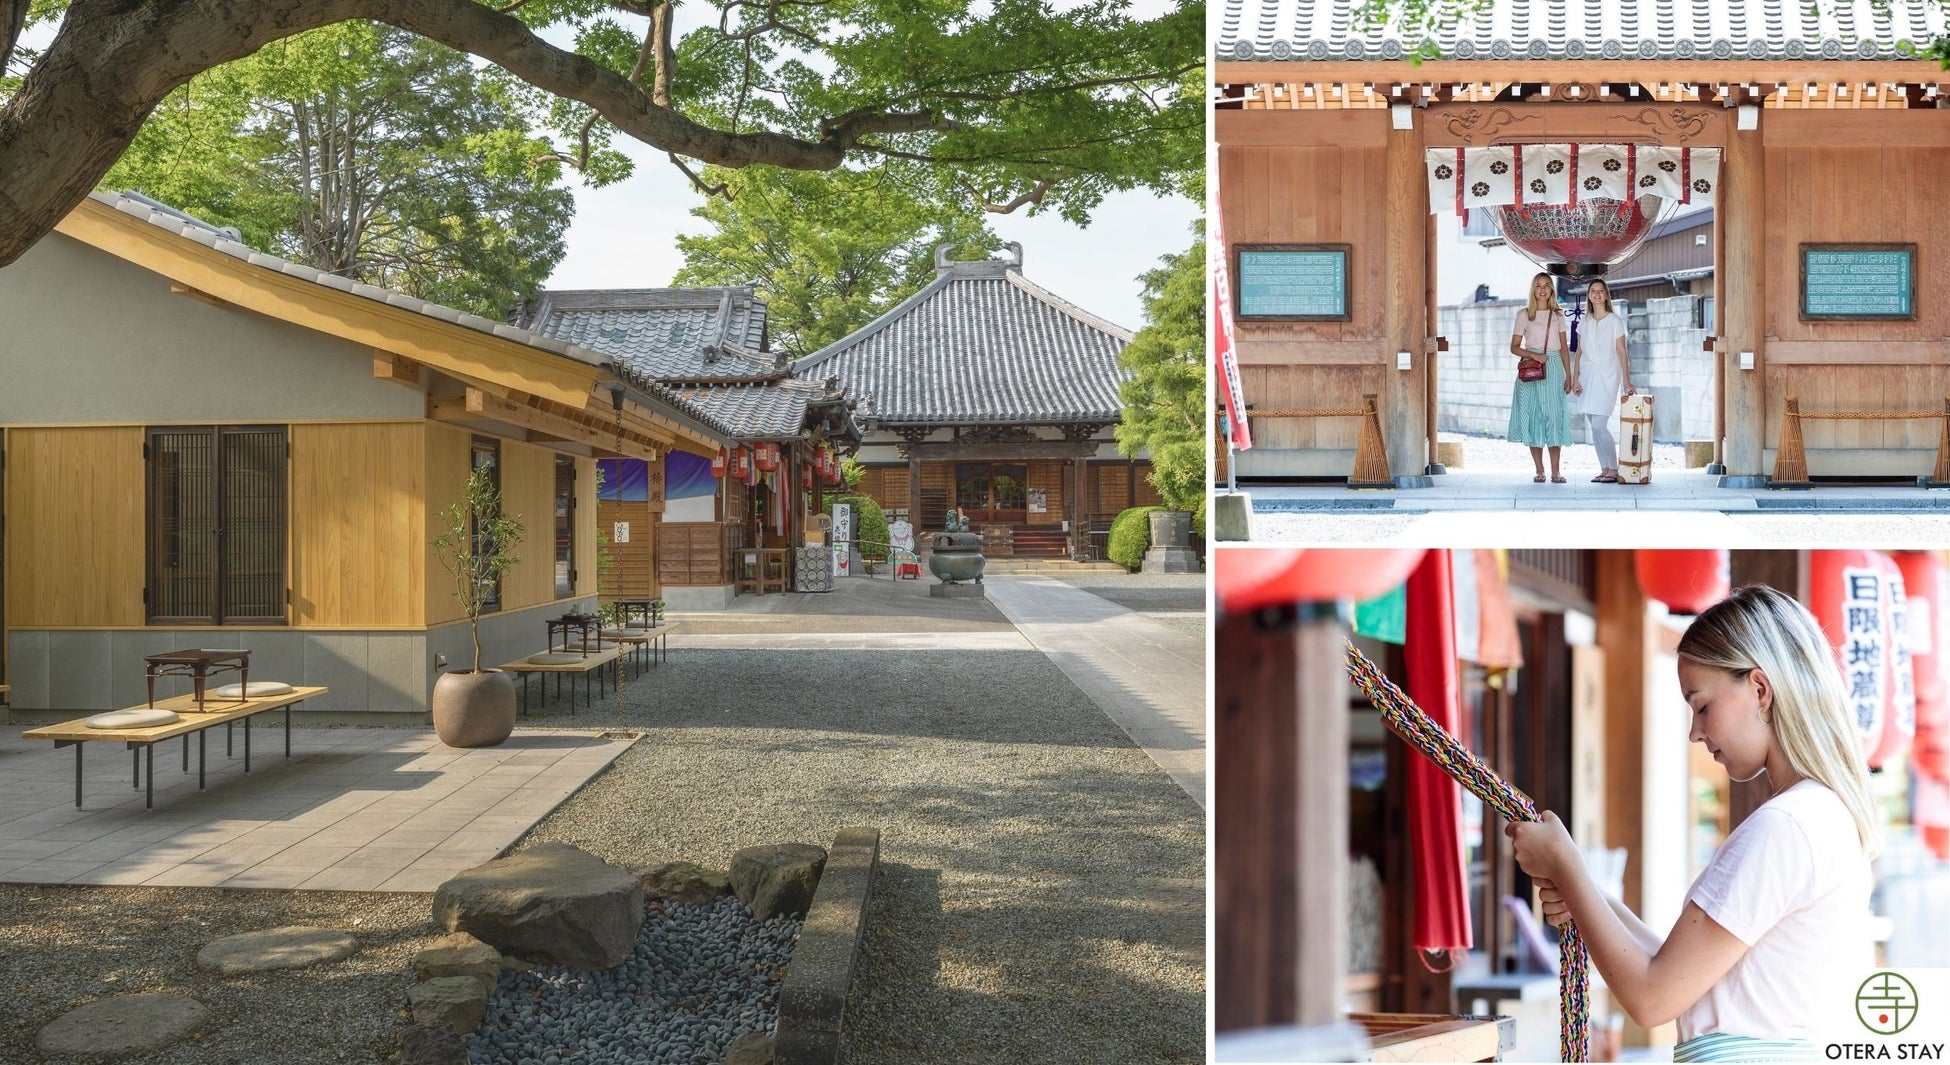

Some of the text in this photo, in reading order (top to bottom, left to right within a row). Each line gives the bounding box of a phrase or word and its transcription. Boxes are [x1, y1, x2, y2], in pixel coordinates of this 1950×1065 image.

[840, 506, 849, 540] 御守り
[1848, 575, 1881, 732] 日限地蔵尊
